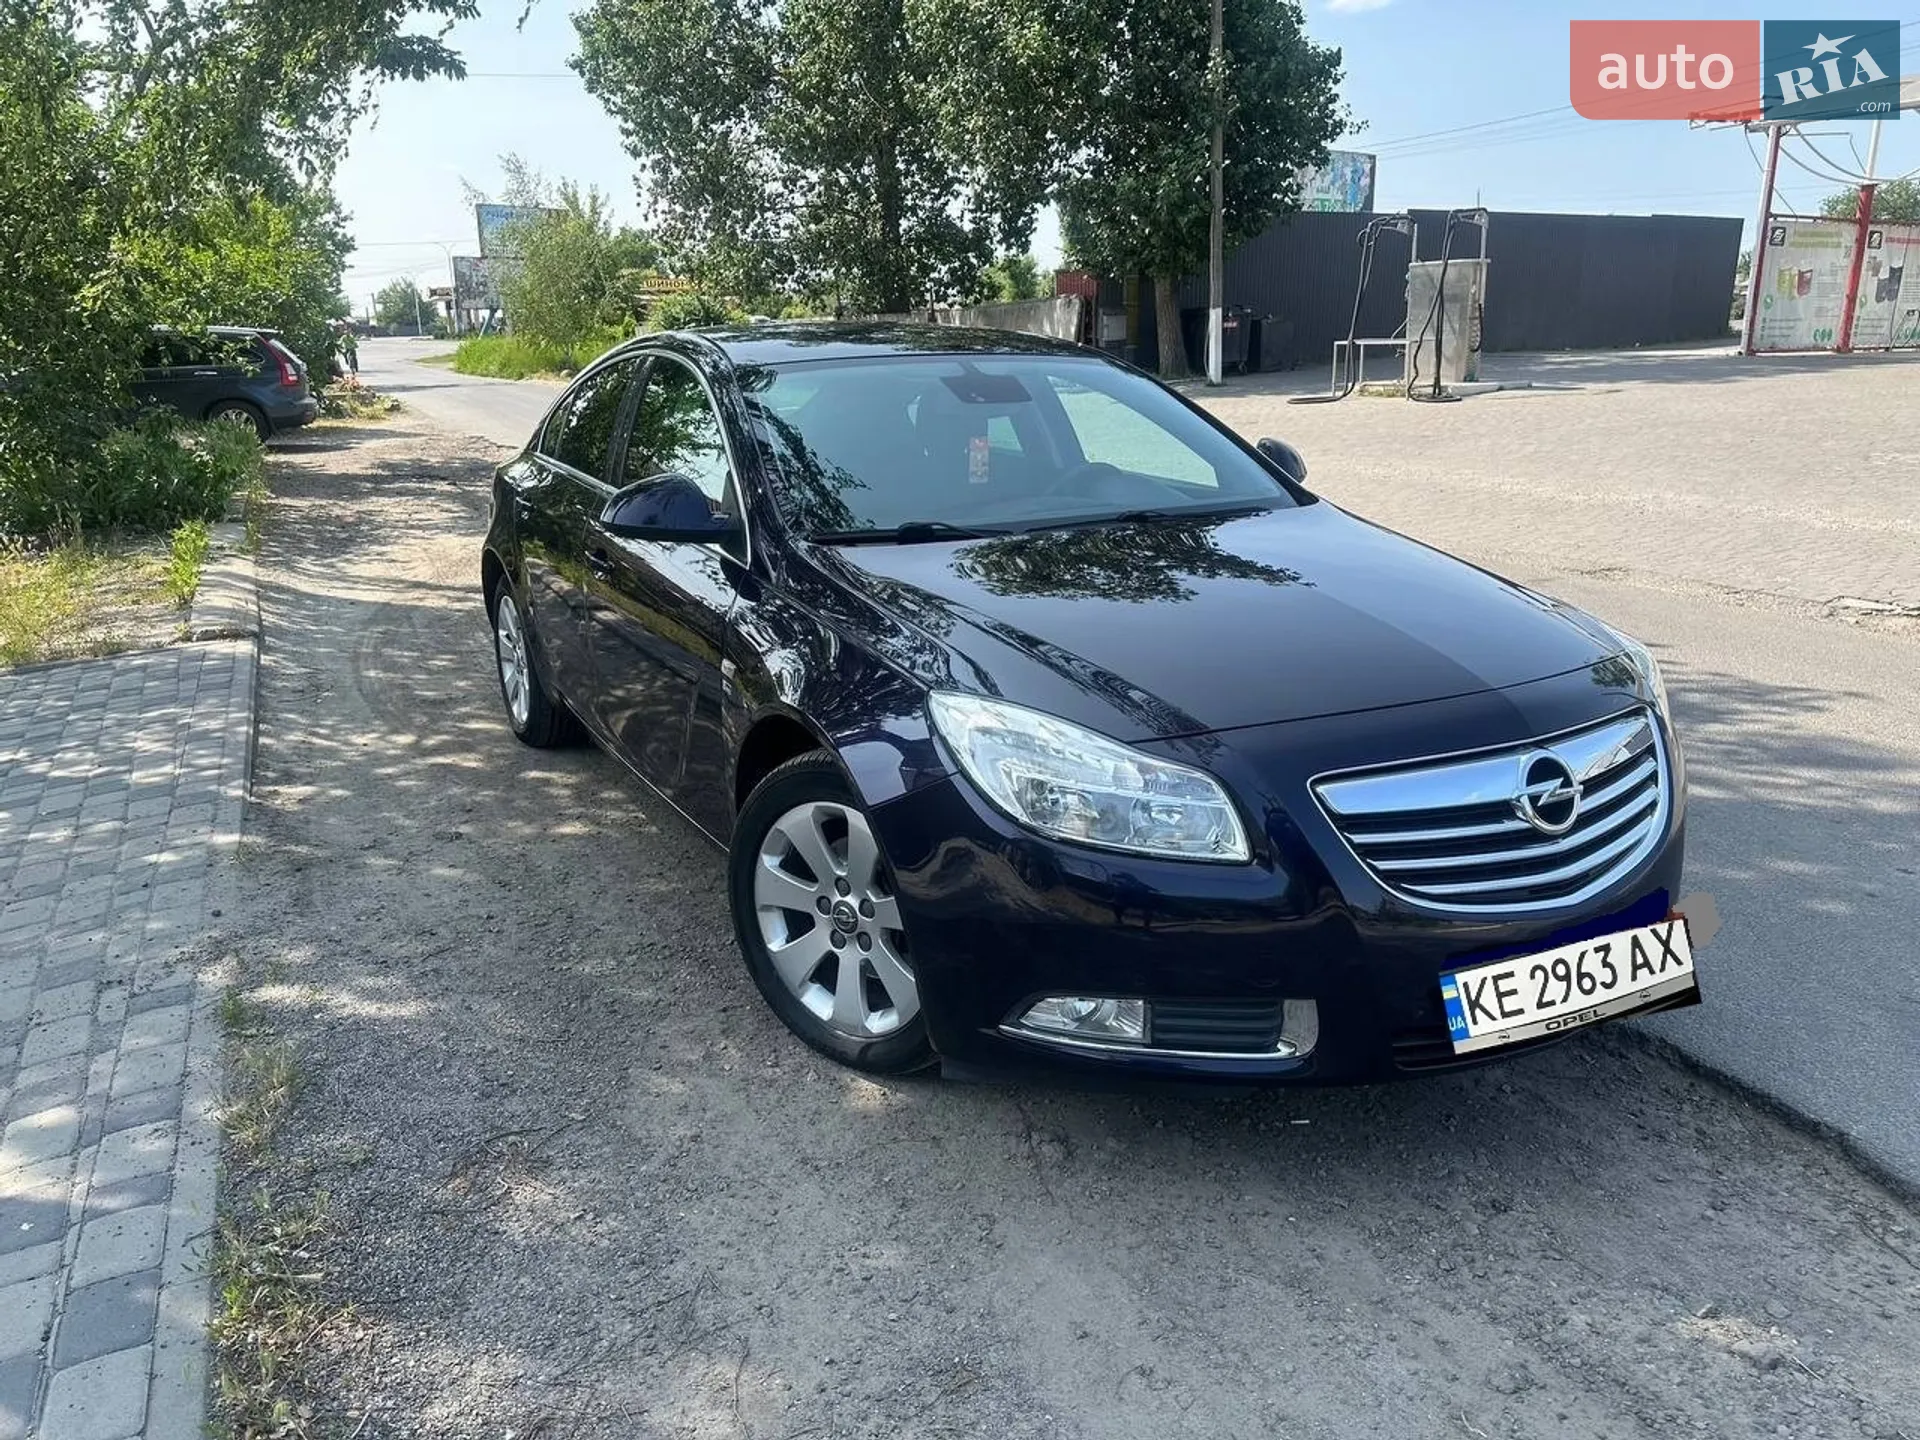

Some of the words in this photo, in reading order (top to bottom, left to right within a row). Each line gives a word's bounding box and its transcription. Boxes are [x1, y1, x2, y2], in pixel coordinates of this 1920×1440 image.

[1462, 970, 1525, 1026] KE
[1529, 942, 1619, 1010] 2963
[1630, 922, 1684, 983] AX
[1448, 1015, 1467, 1032] UA
[1545, 1009, 1607, 1032] OPEL
